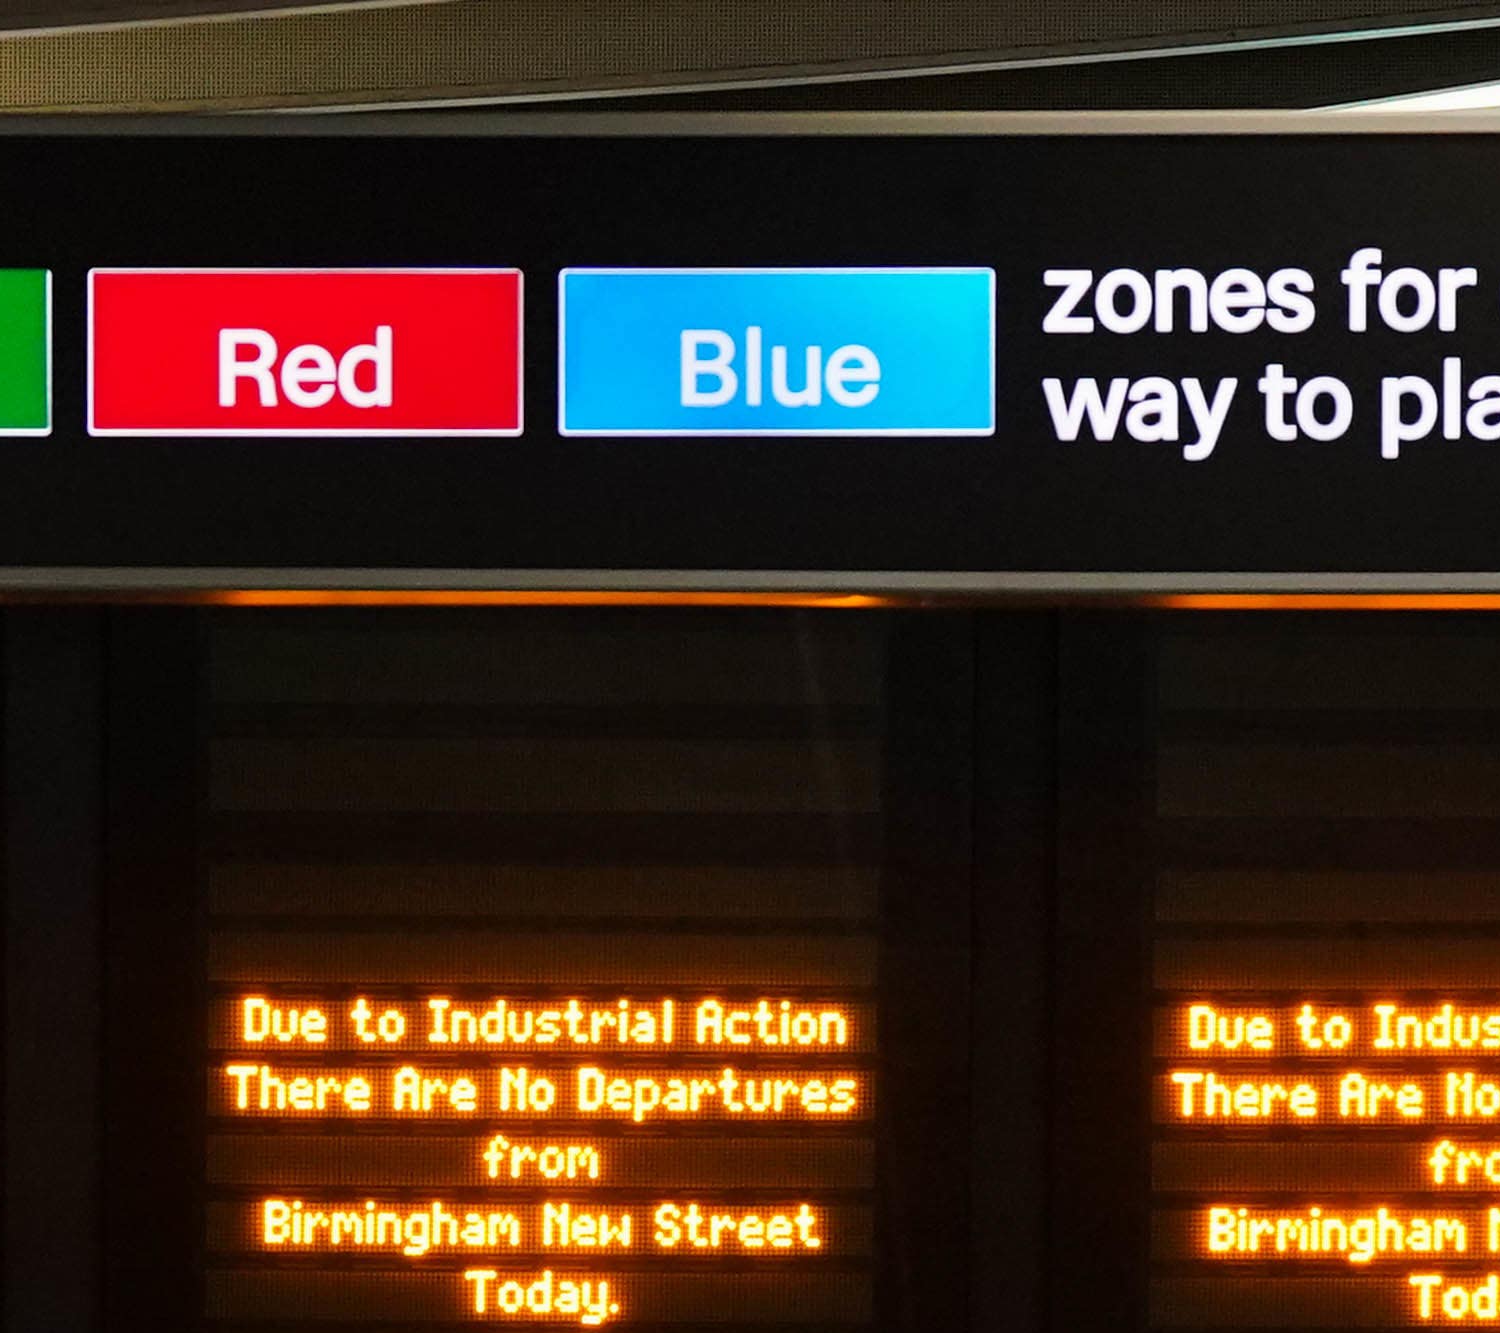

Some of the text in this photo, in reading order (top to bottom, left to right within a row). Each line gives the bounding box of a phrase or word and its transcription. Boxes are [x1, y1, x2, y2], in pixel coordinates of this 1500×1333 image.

[1043, 268, 1315, 333] zones
[1342, 248, 1477, 331] for
[219, 326, 391, 407] Red
[681, 326, 881, 407] Blue
[1043, 377, 1237, 460] way
[1258, 364, 1353, 440] to
[242, 997, 848, 1046] Due to Industrial Action
[1187, 1004, 1276, 1051] Due
[1294, 1004, 1353, 1050] to
[226, 1064, 857, 1122] There Are No Departures
[1171, 1071, 1320, 1118] There
[1335, 1072, 1425, 1118] Are
[482, 1135, 601, 1179] from
[262, 1199, 821, 1256] Birmingham New Street
[1206, 1206, 1468, 1264] Birmingham
[464, 1269, 620, 1325] Today.
